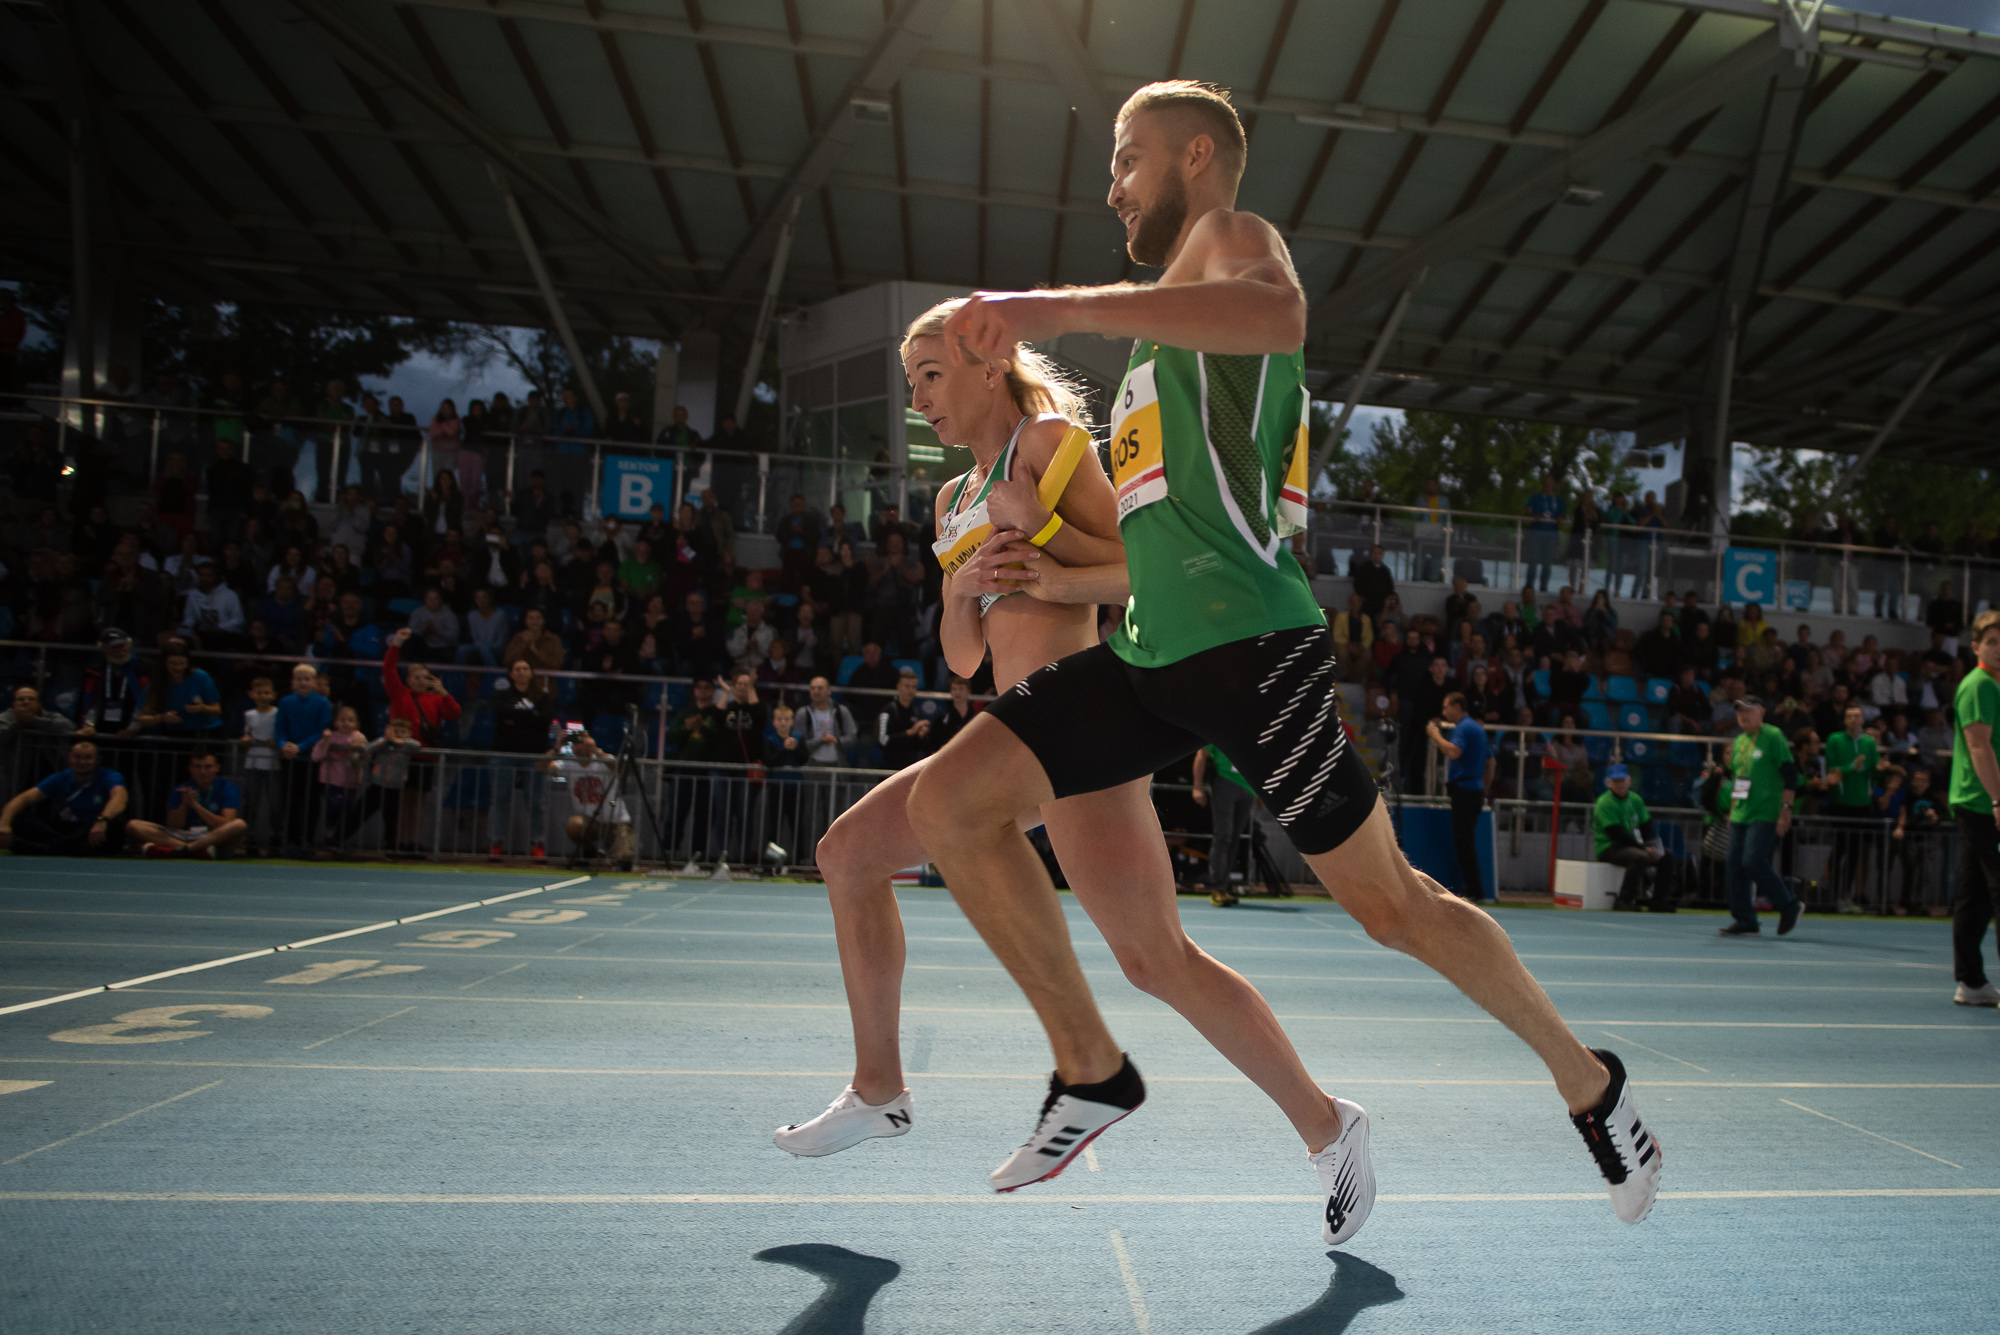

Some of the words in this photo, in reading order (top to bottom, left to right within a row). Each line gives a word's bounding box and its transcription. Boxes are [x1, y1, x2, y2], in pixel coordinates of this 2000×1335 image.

[1124, 377, 1134, 410] 6
[619, 472, 653, 515] B
[1735, 562, 1764, 600] C
[47, 1003, 275, 1045] 3
